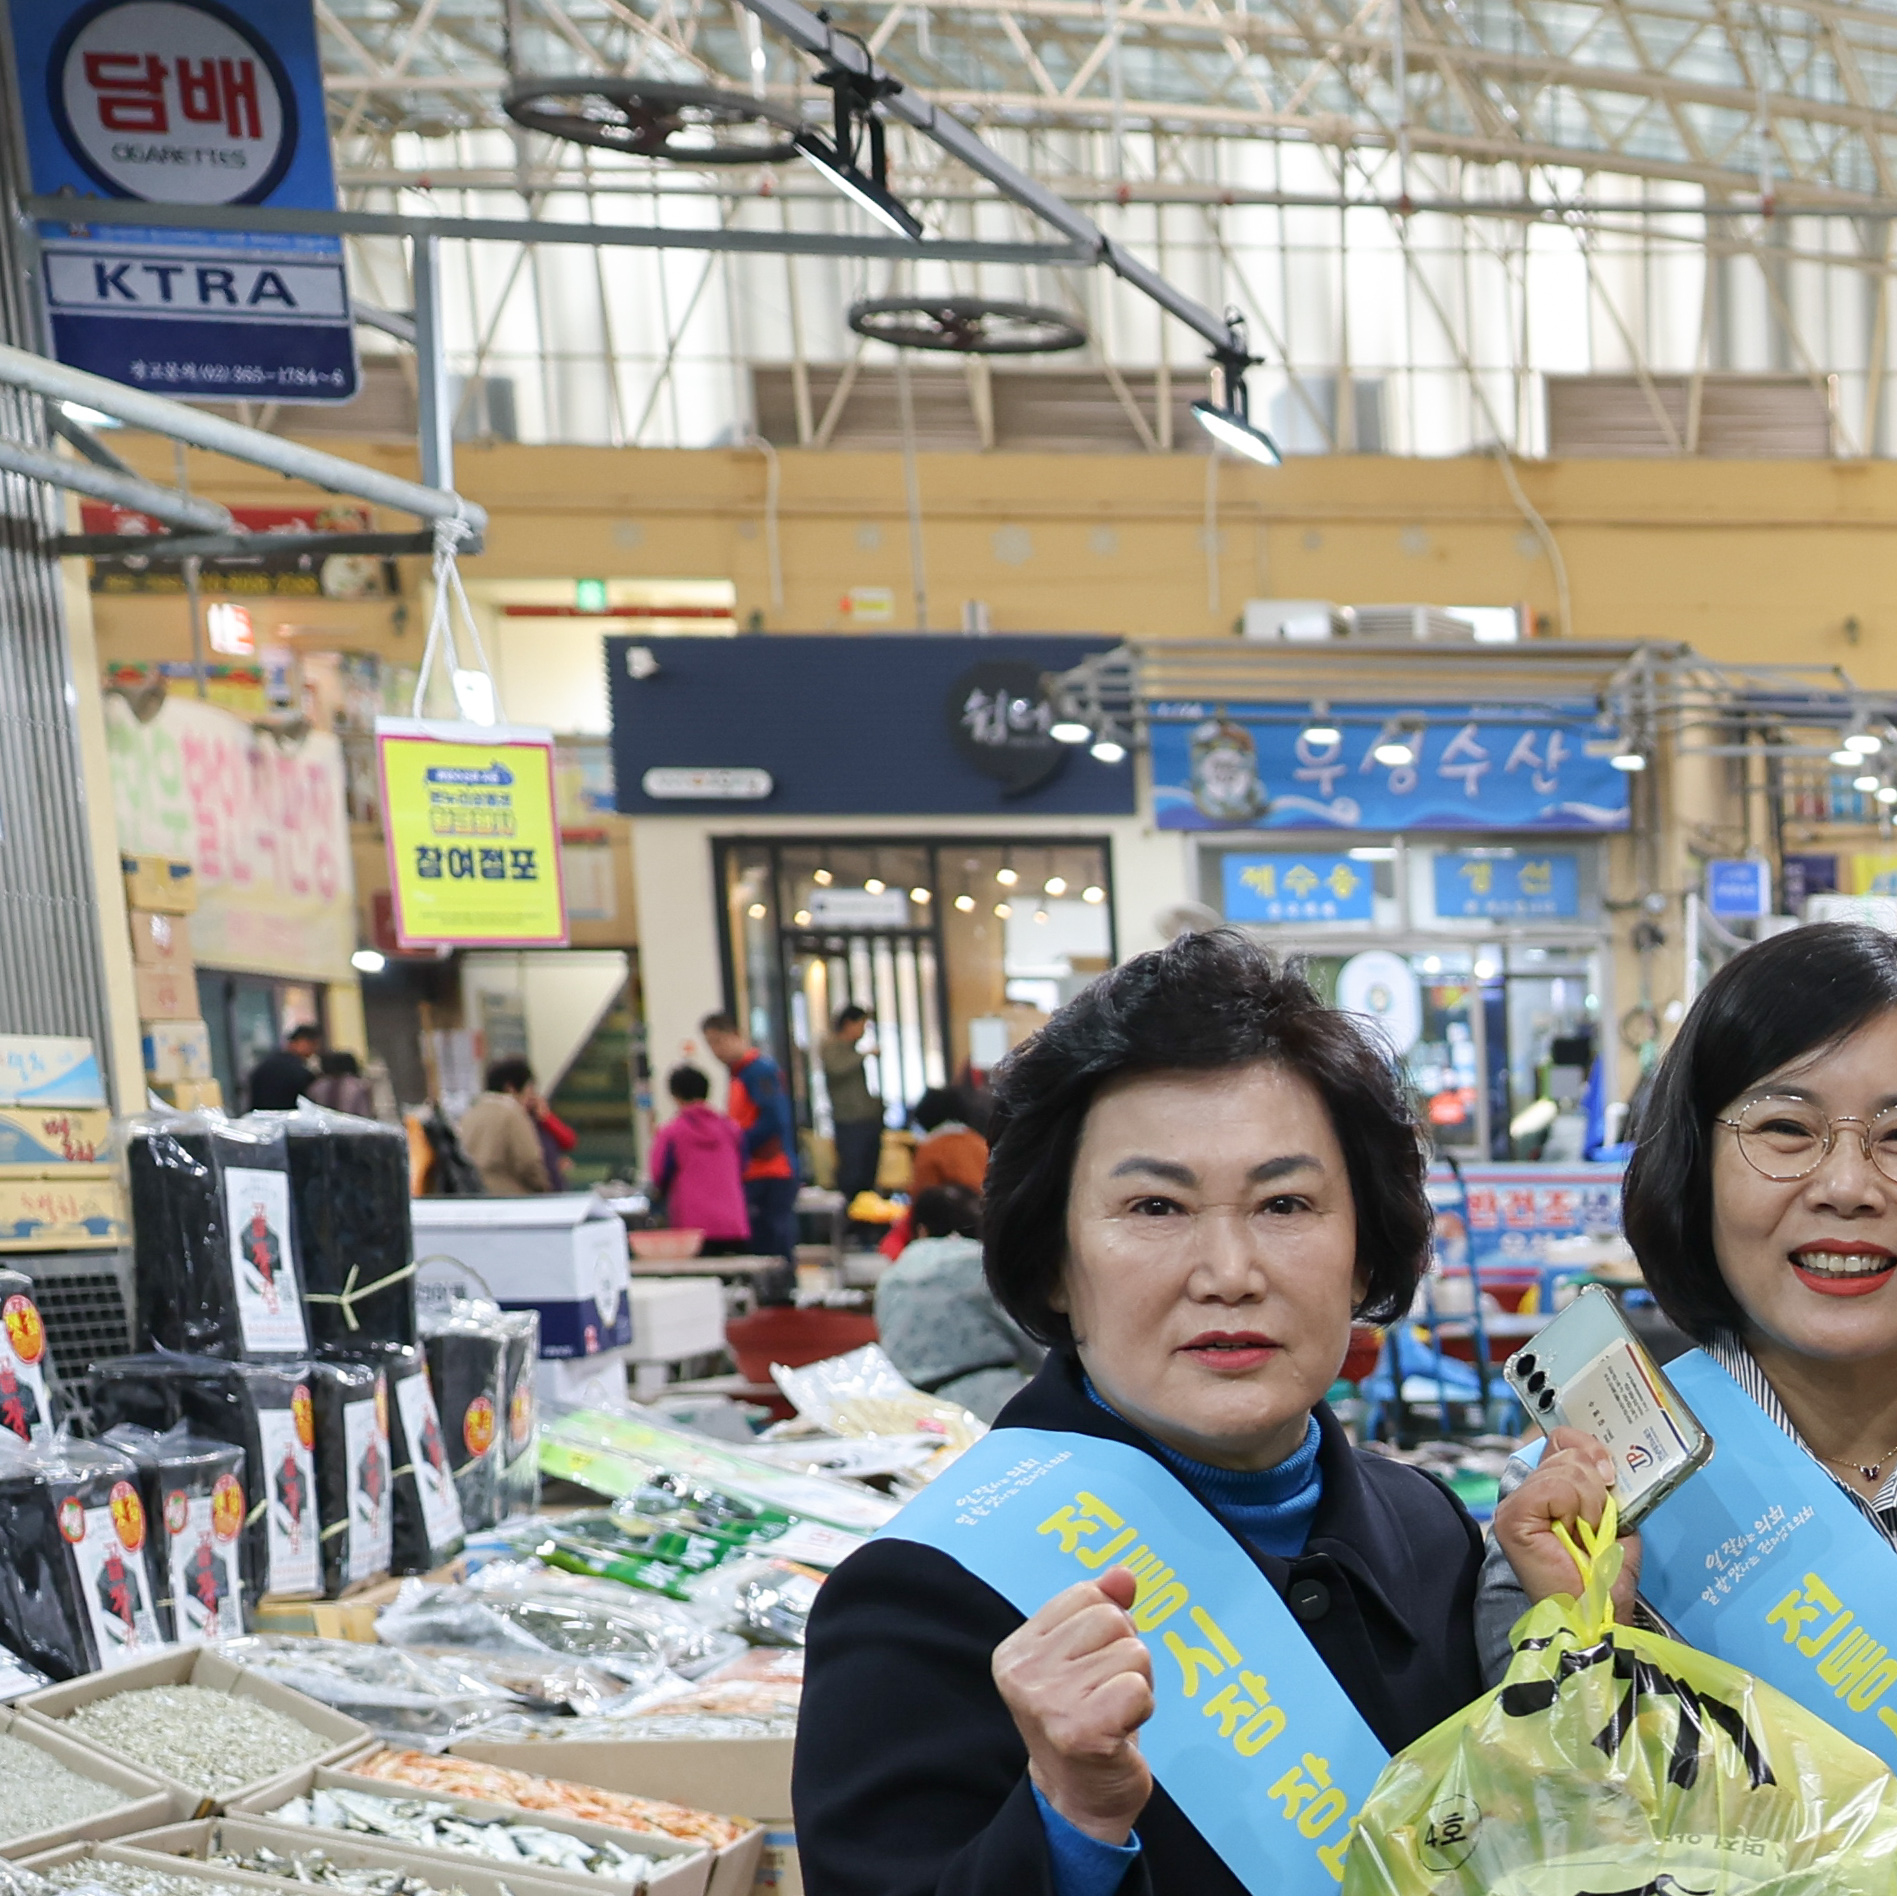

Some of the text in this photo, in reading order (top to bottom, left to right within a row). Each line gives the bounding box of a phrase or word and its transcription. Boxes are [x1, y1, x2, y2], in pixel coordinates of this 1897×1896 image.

[83, 51, 263, 140] 담배
[111, 142, 246, 168] CIGARETTES
[94, 262, 298, 308] KTRA
[415, 846, 537, 880] 참여점포
[1036, 1492, 1287, 1757] 전통시장
[1425, 1812, 1466, 1848] 4호
